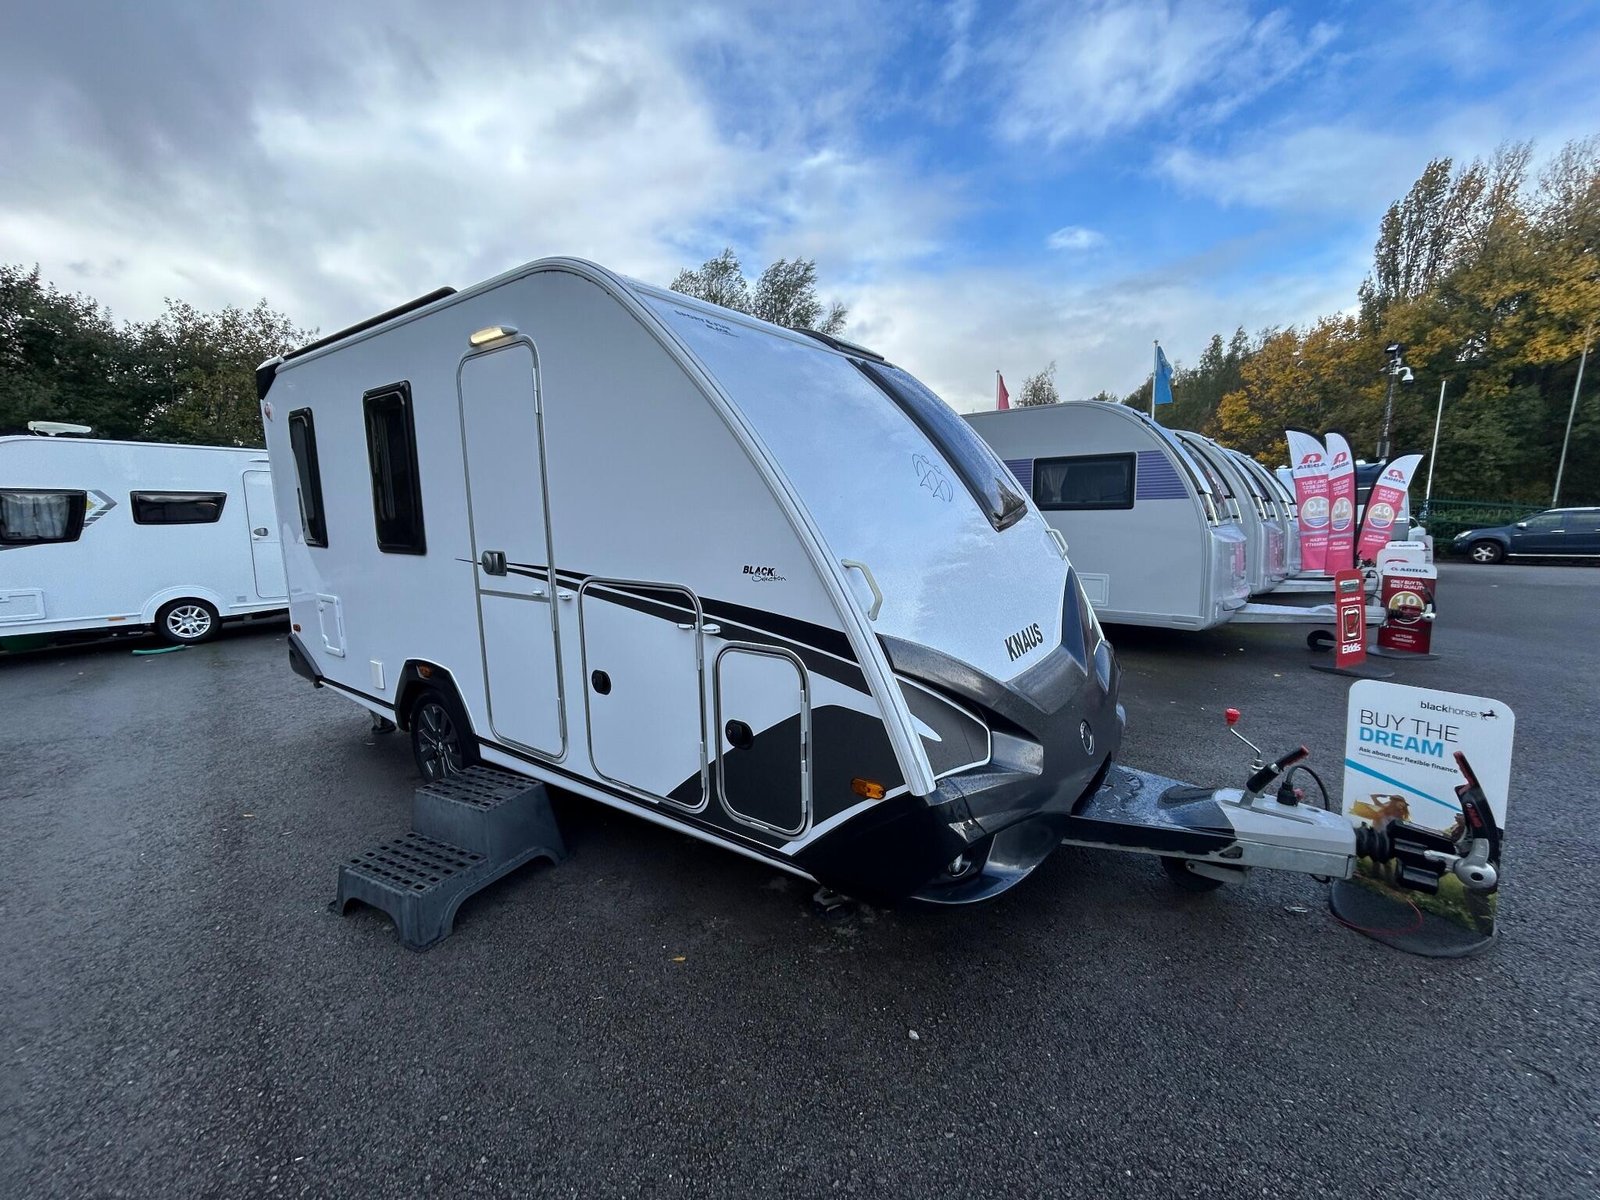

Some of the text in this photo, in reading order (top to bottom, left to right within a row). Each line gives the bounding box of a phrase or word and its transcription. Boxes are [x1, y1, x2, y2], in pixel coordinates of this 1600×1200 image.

[743, 565, 775, 577] BLACK
[1397, 595, 1418, 606] 10
[1004, 623, 1044, 662] KNAUS
[1420, 701, 1478, 718] blackhorse
[1360, 709, 1460, 743] BUY THE
[1359, 726, 1444, 758] DREAM
[1359, 746, 1371, 754] Ask
[1371, 750, 1391, 759] about
[1404, 756, 1430, 767] flexible
[1431, 762, 1458, 774] finance
